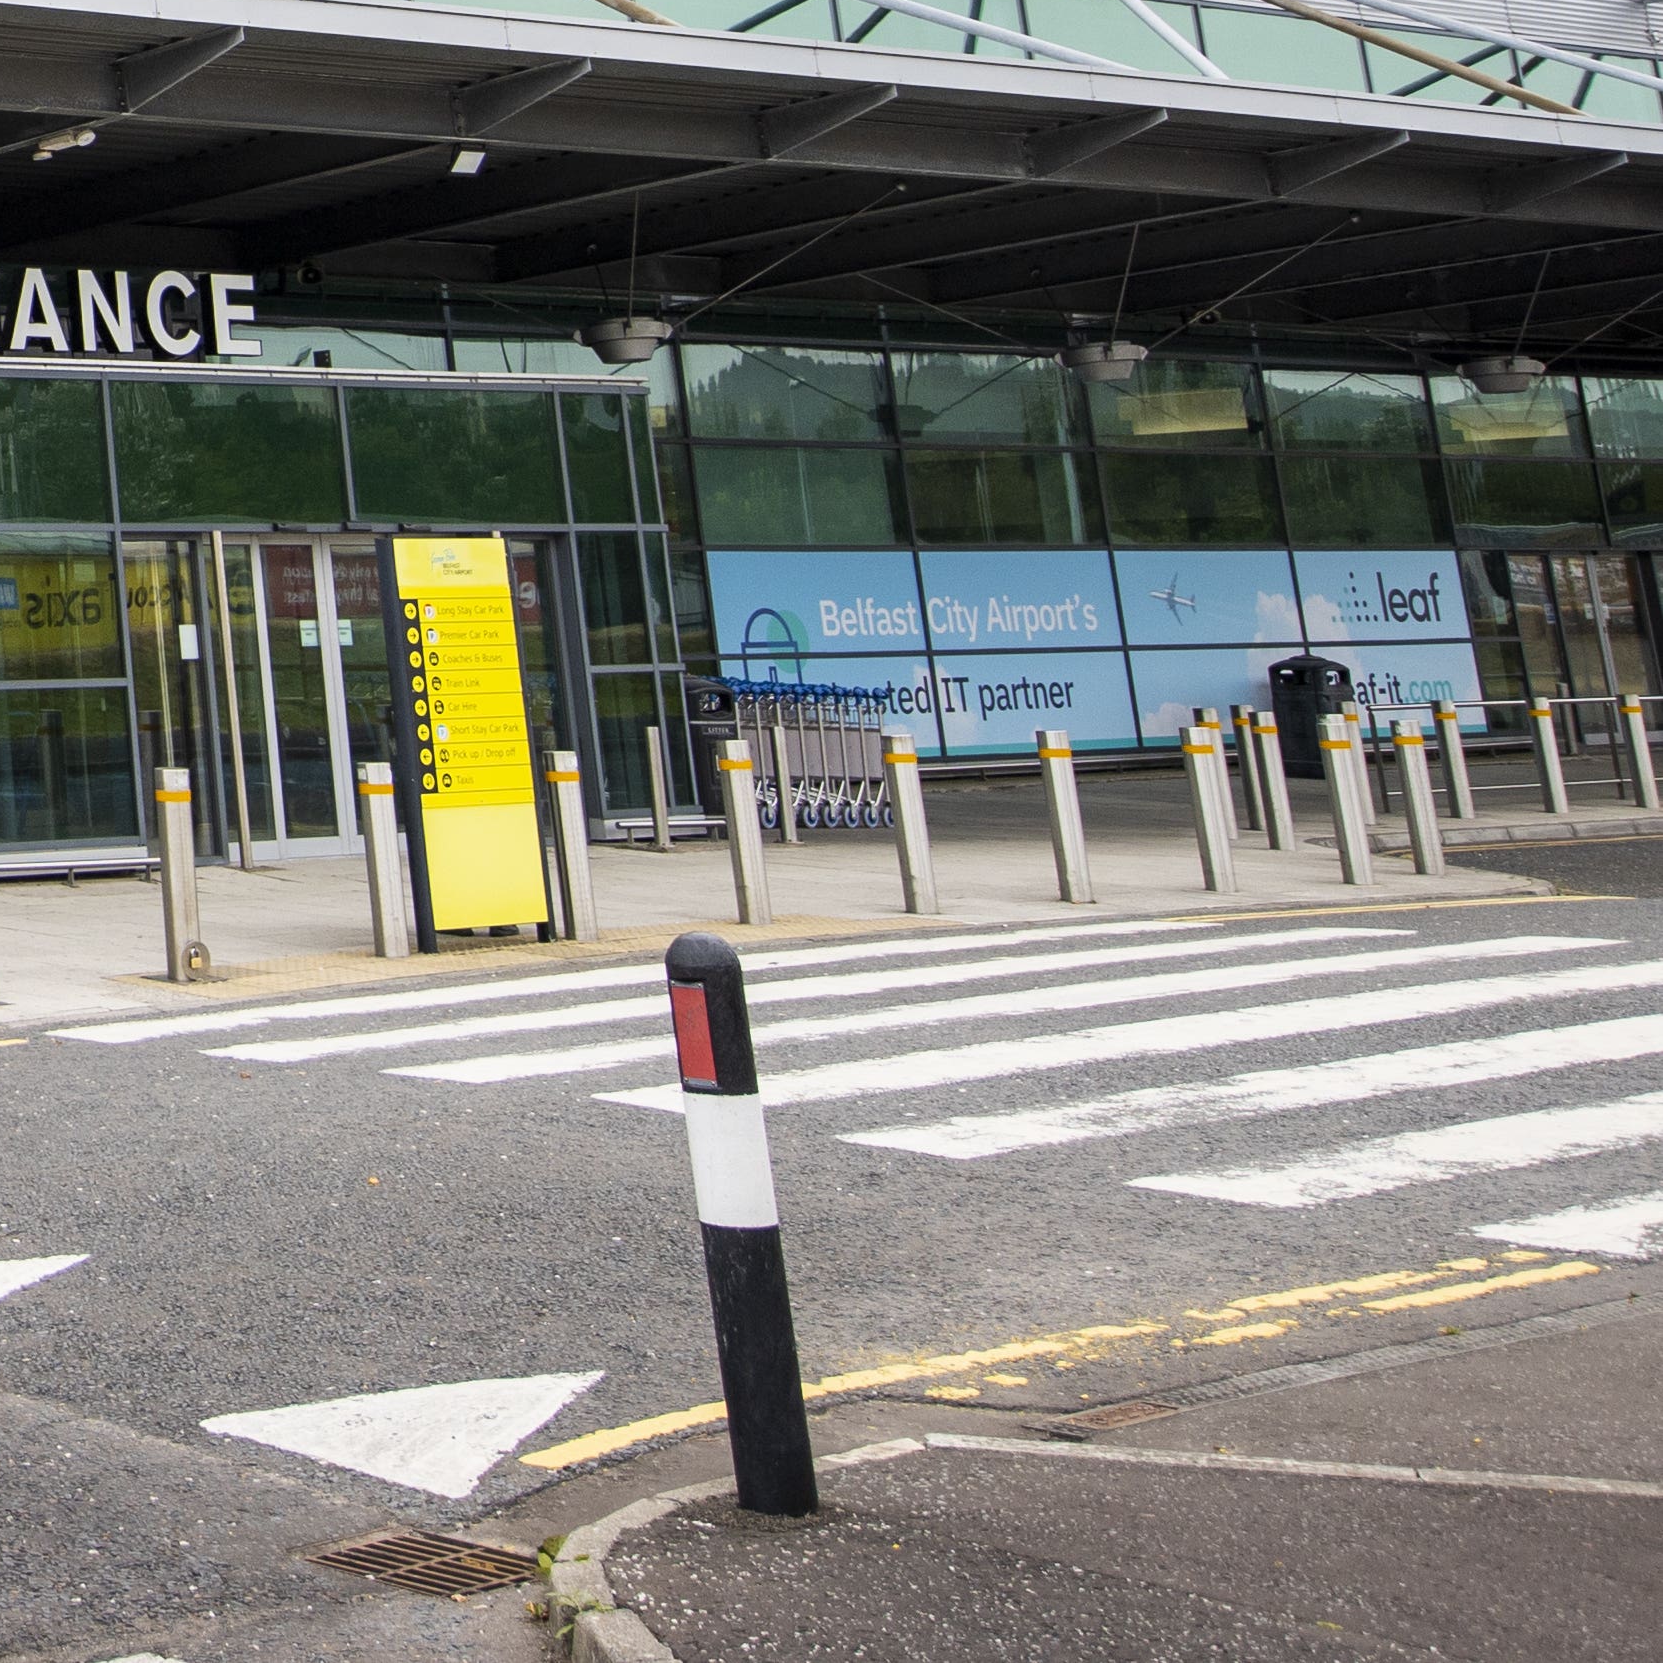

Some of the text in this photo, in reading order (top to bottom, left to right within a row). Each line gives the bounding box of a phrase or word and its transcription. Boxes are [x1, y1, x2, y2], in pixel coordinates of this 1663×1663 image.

[1376, 571, 1441, 623] leaf
[437, 604, 505, 617] Long Stay Car Park
[818, 597, 919, 636] Belfast
[927, 596, 979, 642] City
[440, 629, 499, 639] Premier Car Park
[443, 653, 503, 664] Coaches & Buses
[446, 678, 480, 688] Train Link
[941, 676, 969, 713] IT
[978, 679, 1074, 721] partner
[448, 701, 477, 711] Car Hire
[450, 723, 520, 739] Short Stay Car Park
[452, 749, 467, 758] Pick
[470, 751, 479, 760] up
[486, 748, 504, 760] Drop
[505, 747, 516, 757] off
[456, 775, 474, 785] Taxis
